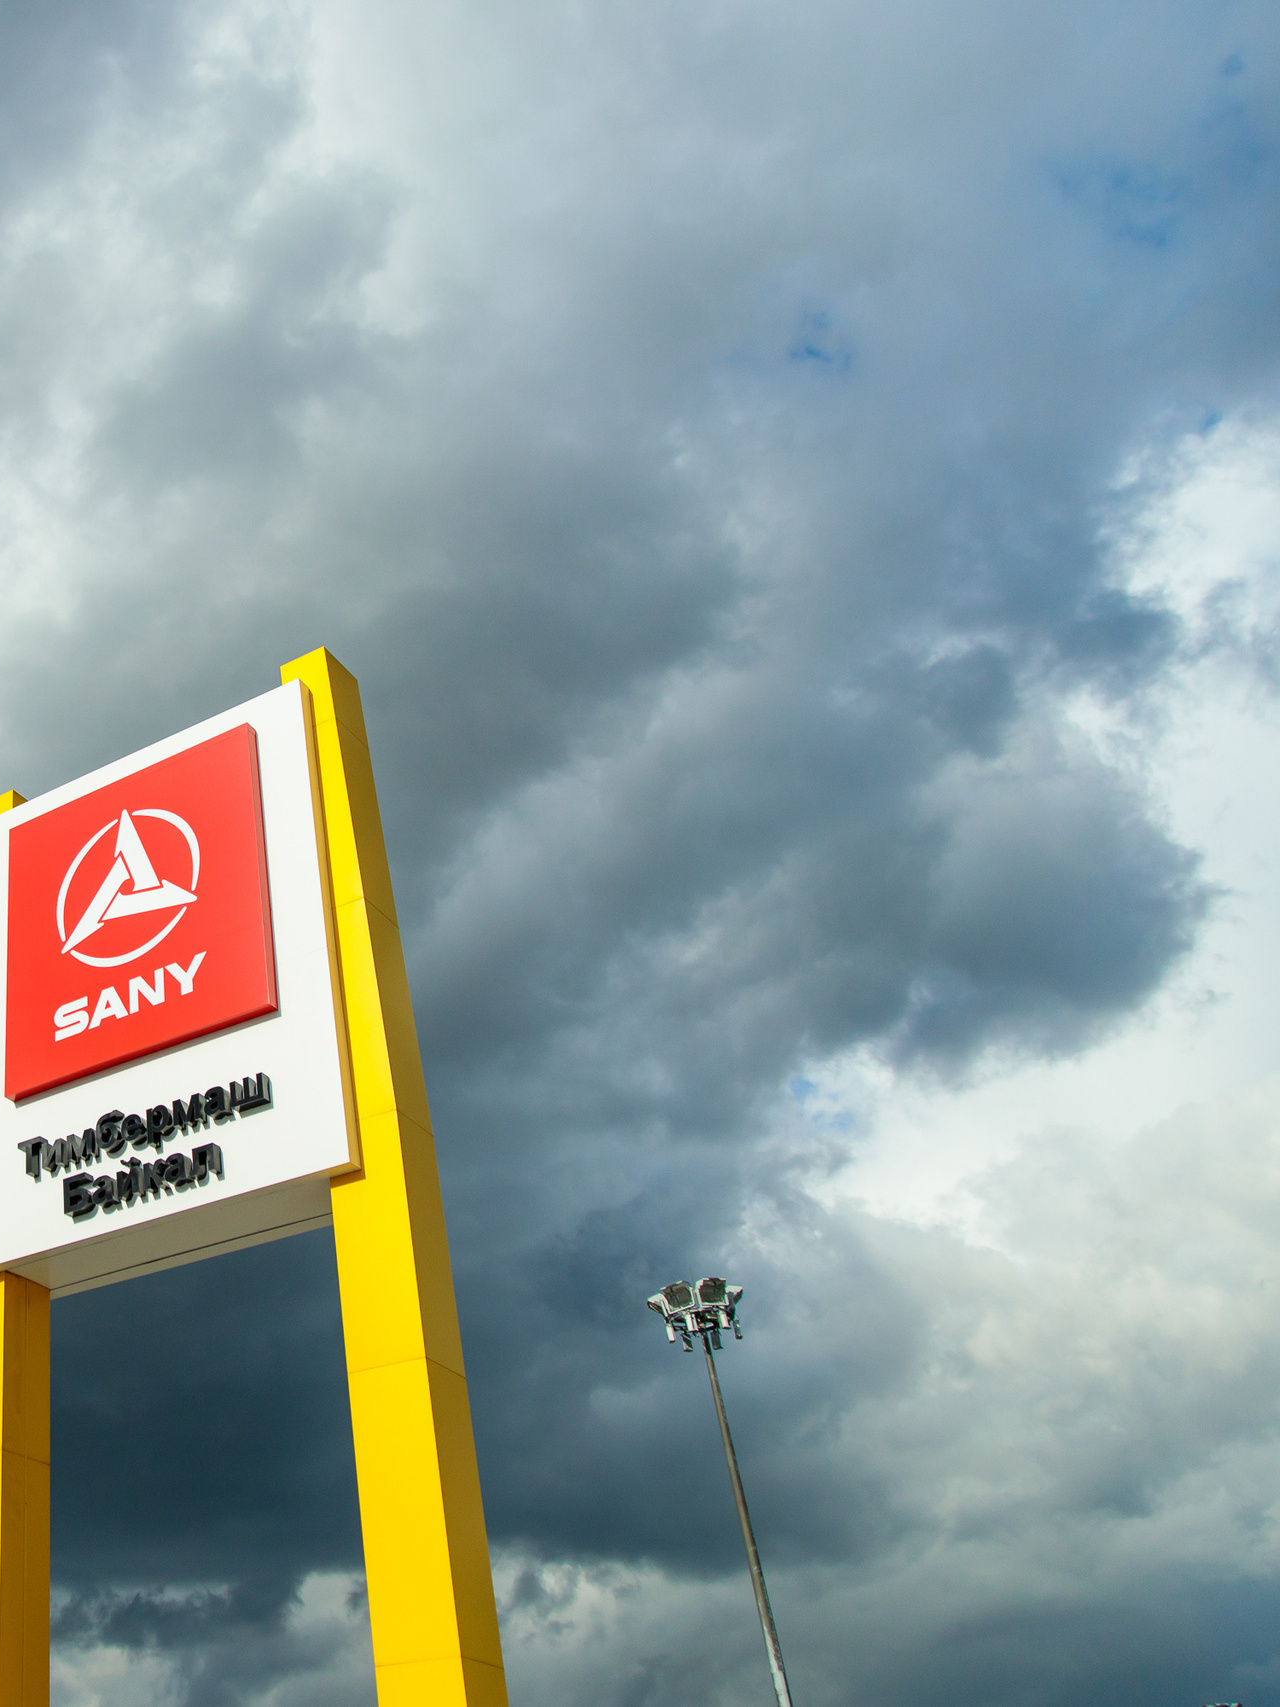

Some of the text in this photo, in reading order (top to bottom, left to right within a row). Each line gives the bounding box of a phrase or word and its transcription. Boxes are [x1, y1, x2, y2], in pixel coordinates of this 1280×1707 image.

[54, 951, 207, 1042] SANY
[18, 1072, 272, 1178] Тимбермаш
[63, 1143, 223, 1218] Байкал
